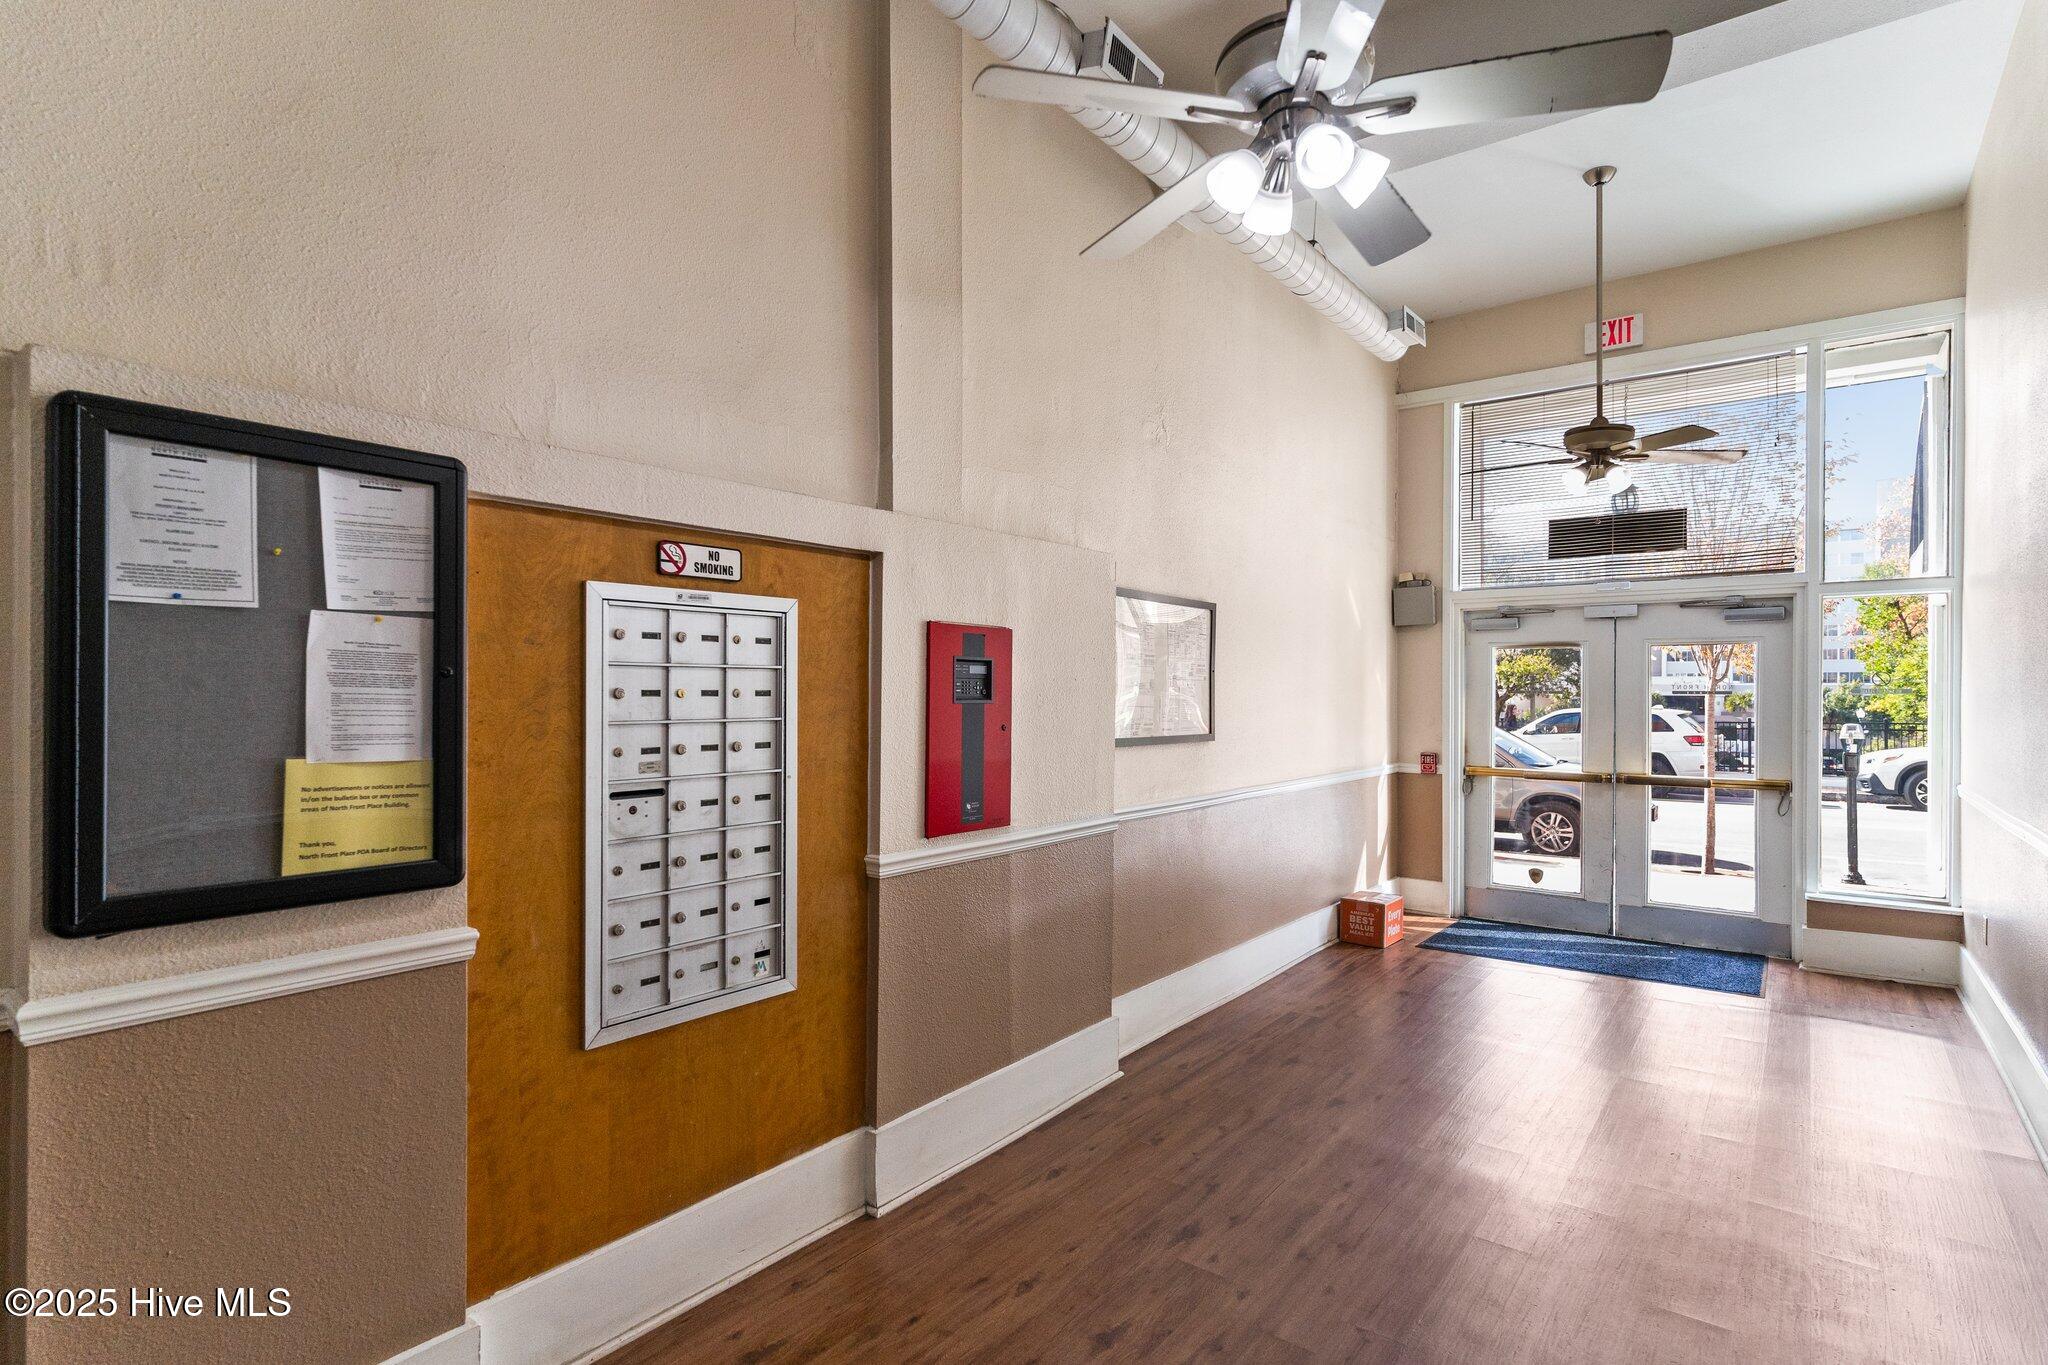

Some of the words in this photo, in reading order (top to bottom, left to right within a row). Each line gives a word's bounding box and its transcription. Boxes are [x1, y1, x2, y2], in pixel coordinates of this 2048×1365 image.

[708, 550, 720, 562] NO
[694, 561, 734, 576] SMOKING
[1421, 755, 1434, 764] FIRE
[1349, 914, 1375, 926] BEST
[1349, 923, 1375, 933] VALUE
